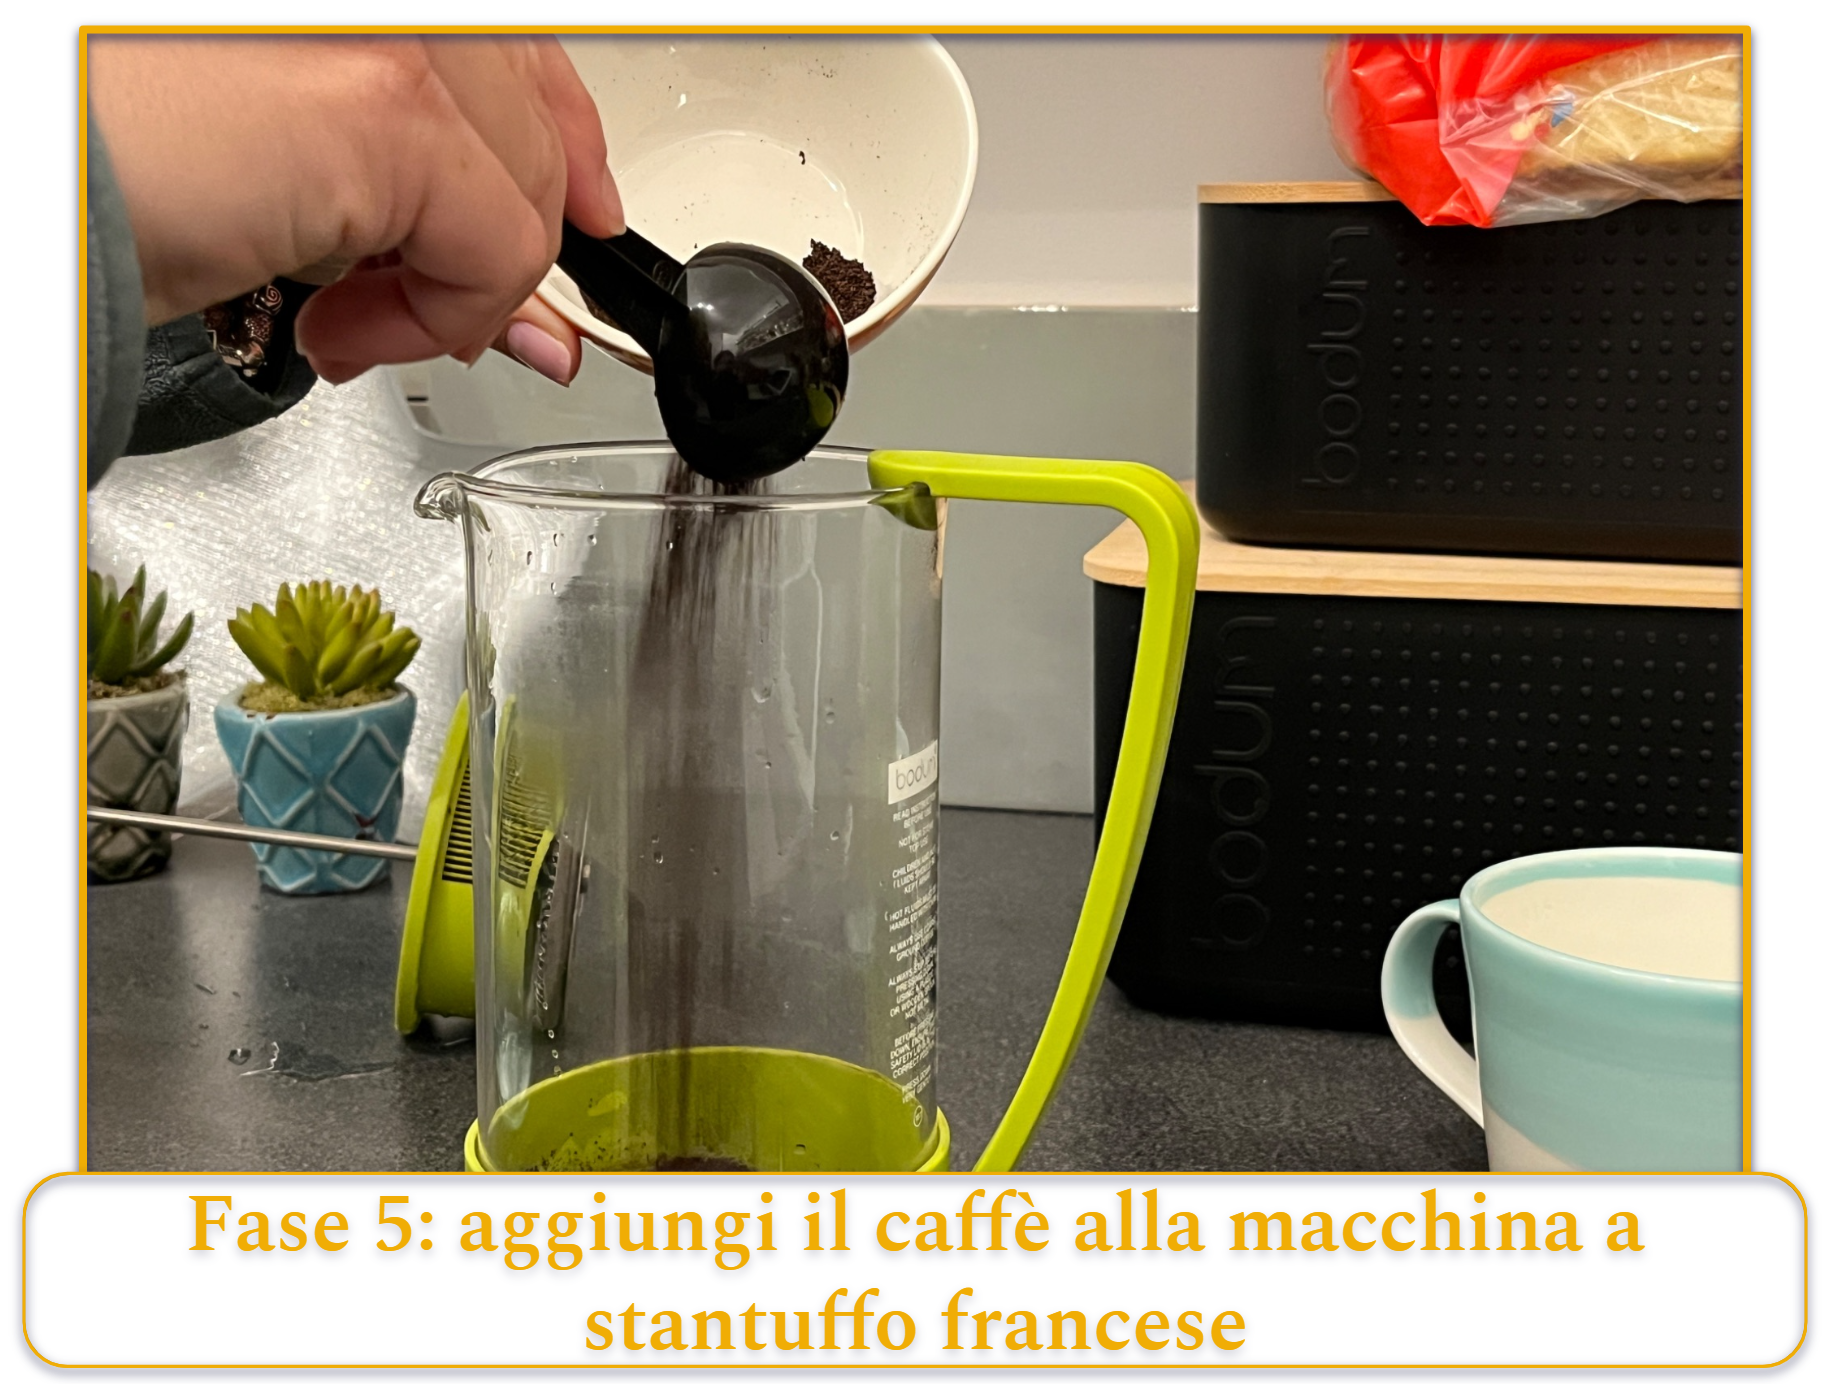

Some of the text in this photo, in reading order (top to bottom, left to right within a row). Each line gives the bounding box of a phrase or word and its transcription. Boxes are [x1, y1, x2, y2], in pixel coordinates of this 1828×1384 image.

[1301, 225, 1370, 484] bodum
[1190, 615, 1278, 945] bodum
[893, 808, 911, 823] READ
[899, 835, 911, 848] NOT
[889, 912, 918, 933] HANDLED
[890, 908, 903, 922] HOT
[889, 934, 914, 954] ALWAYS
[888, 967, 913, 988] ALWAYS
[890, 1005, 900, 1018] OR
[894, 1026, 917, 1048] BEFORE
[890, 1049, 913, 1070] SAFETY
[893, 1055, 919, 1079] CORRECT
